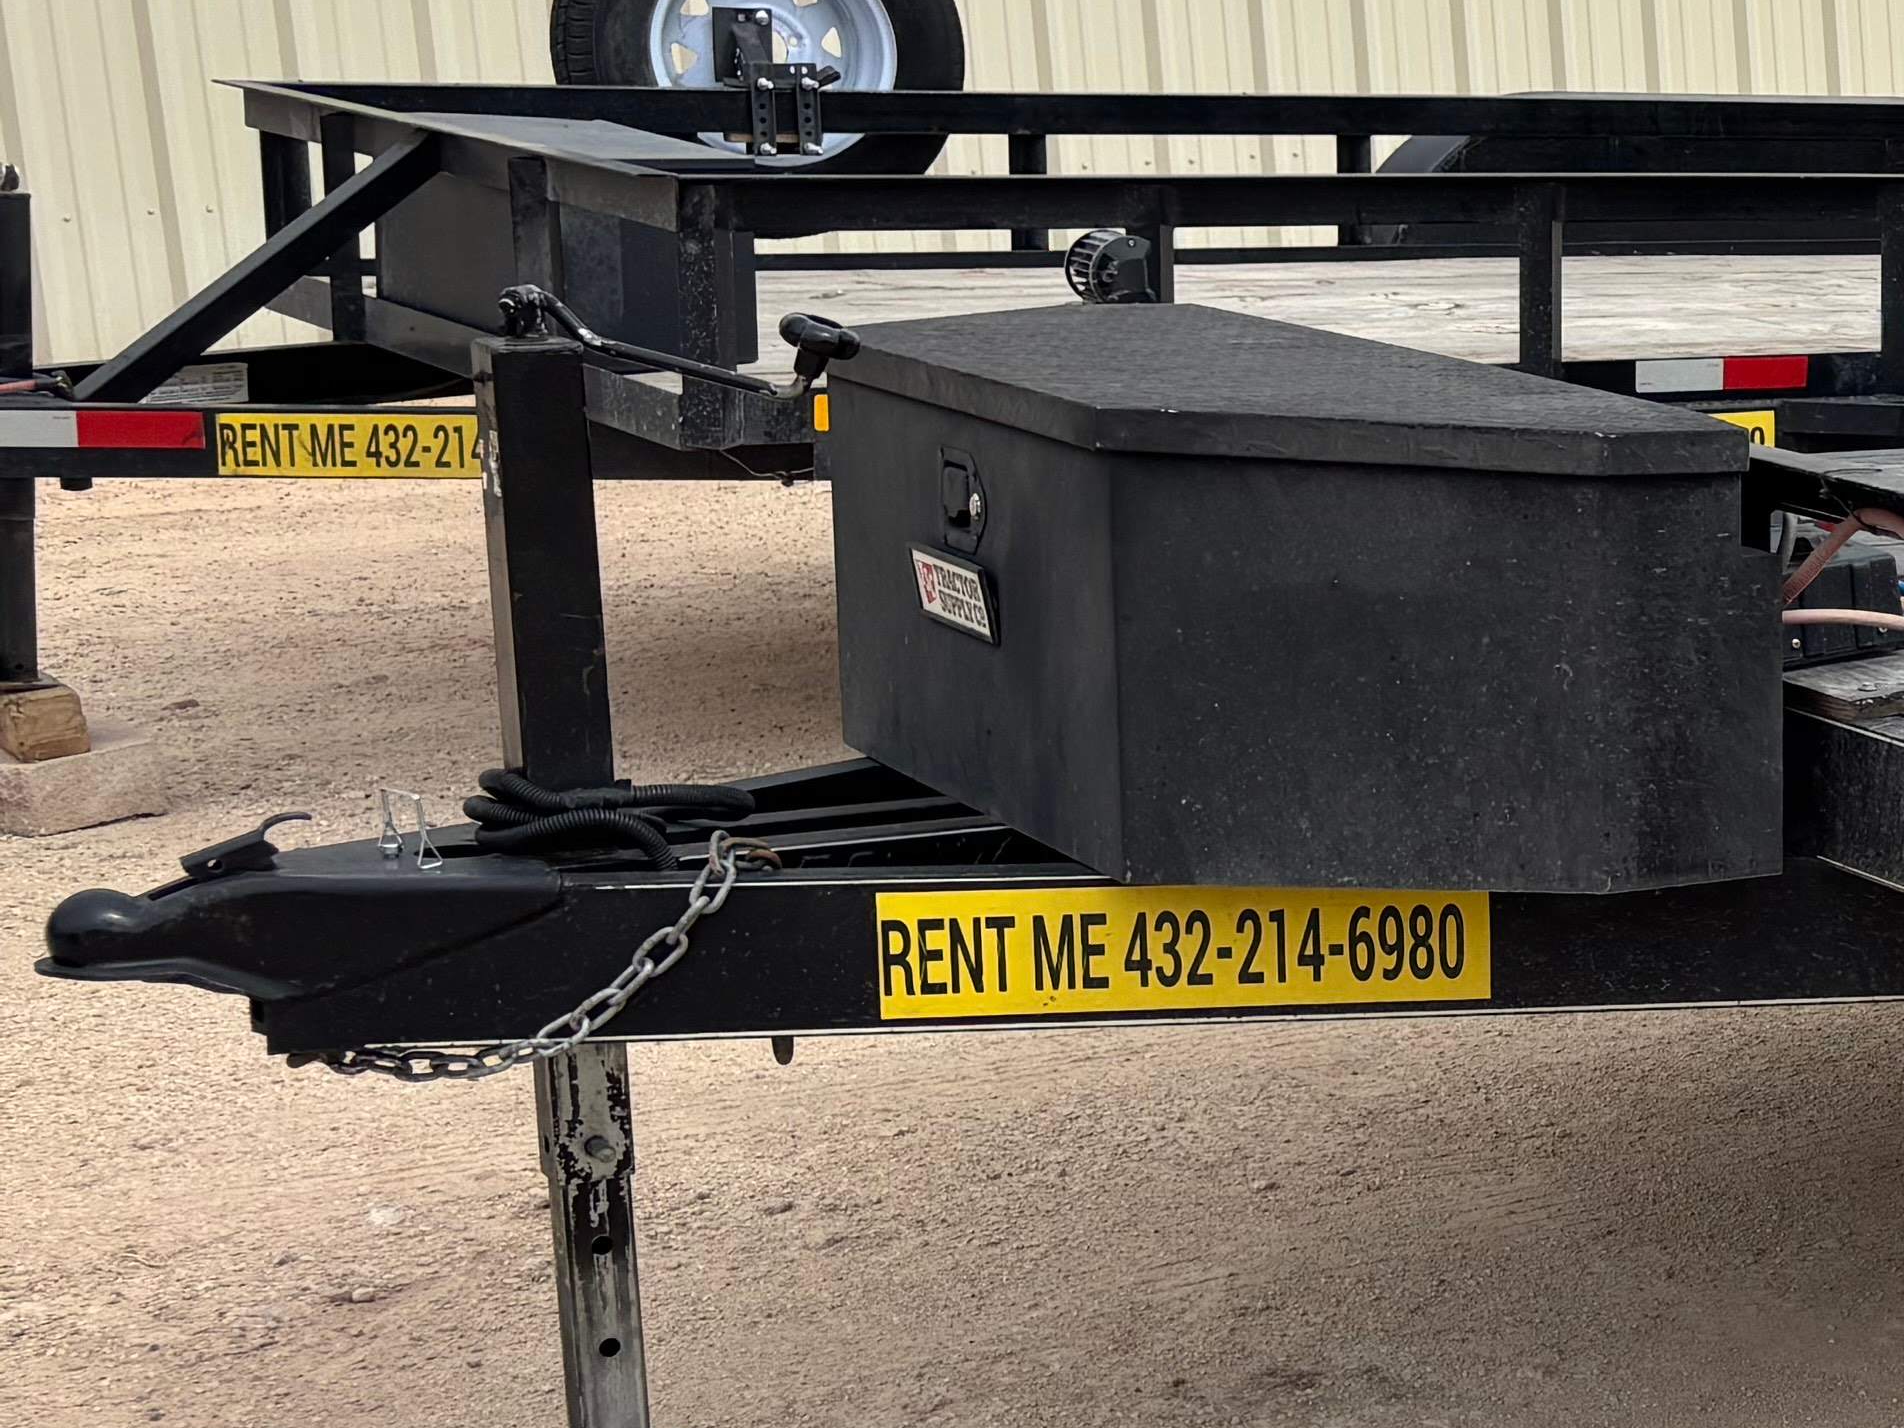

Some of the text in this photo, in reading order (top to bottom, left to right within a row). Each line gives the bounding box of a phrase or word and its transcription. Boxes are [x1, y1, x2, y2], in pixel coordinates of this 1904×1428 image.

[218, 422, 299, 468] RENT
[309, 422, 357, 468] ME
[932, 563, 981, 603] TRACTOR
[938, 589, 974, 624] SUPPLY
[880, 902, 1466, 997] RENT ME 432-214-6980
